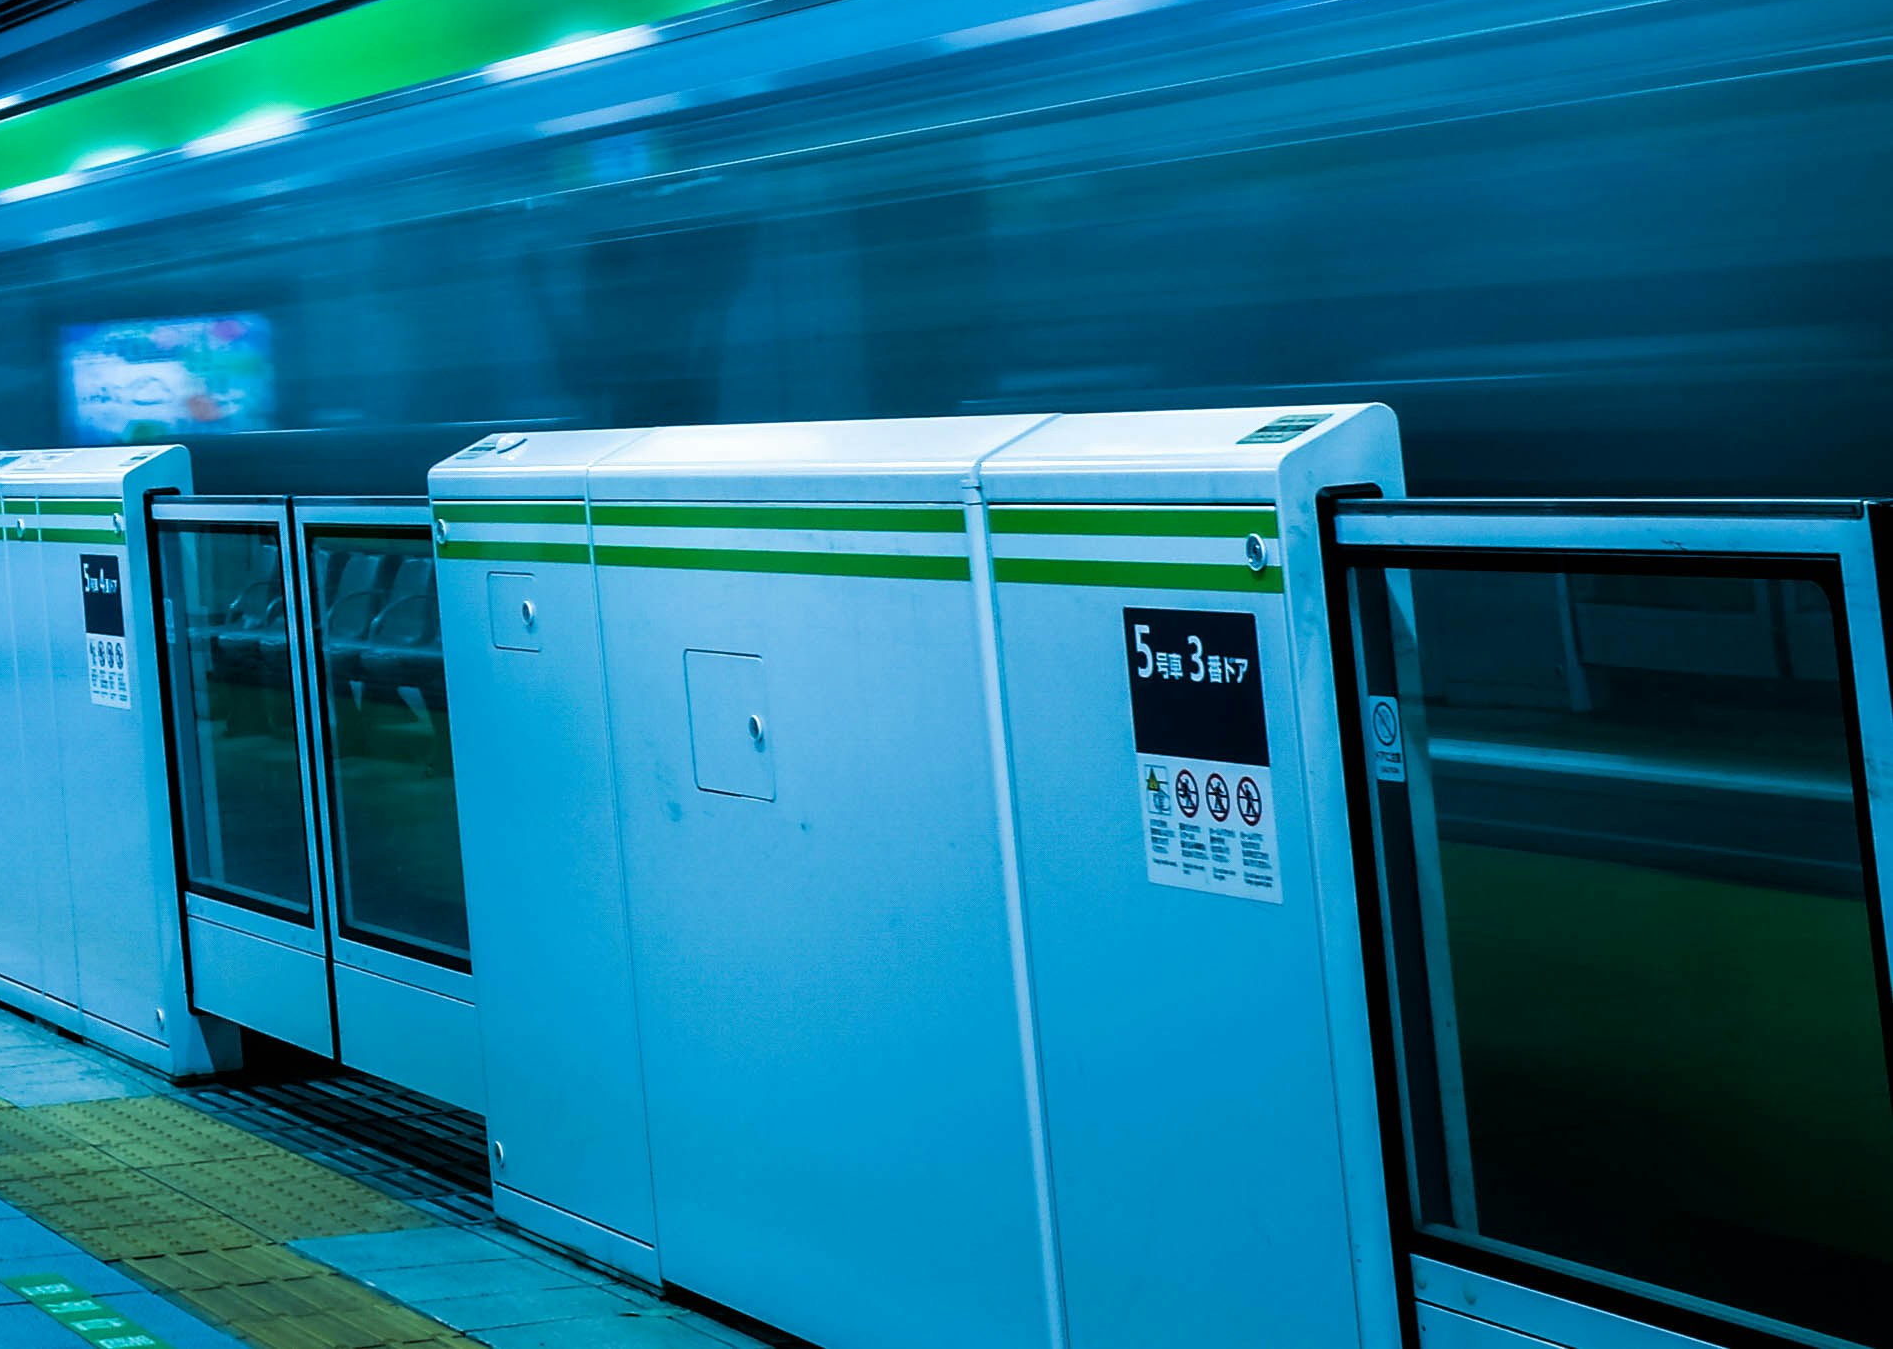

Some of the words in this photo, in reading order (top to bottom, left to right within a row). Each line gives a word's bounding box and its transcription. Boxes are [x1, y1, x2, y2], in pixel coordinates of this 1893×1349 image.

[1134, 624, 1184, 680] 5号車
[1187, 635, 1249, 684] 3番ドア
